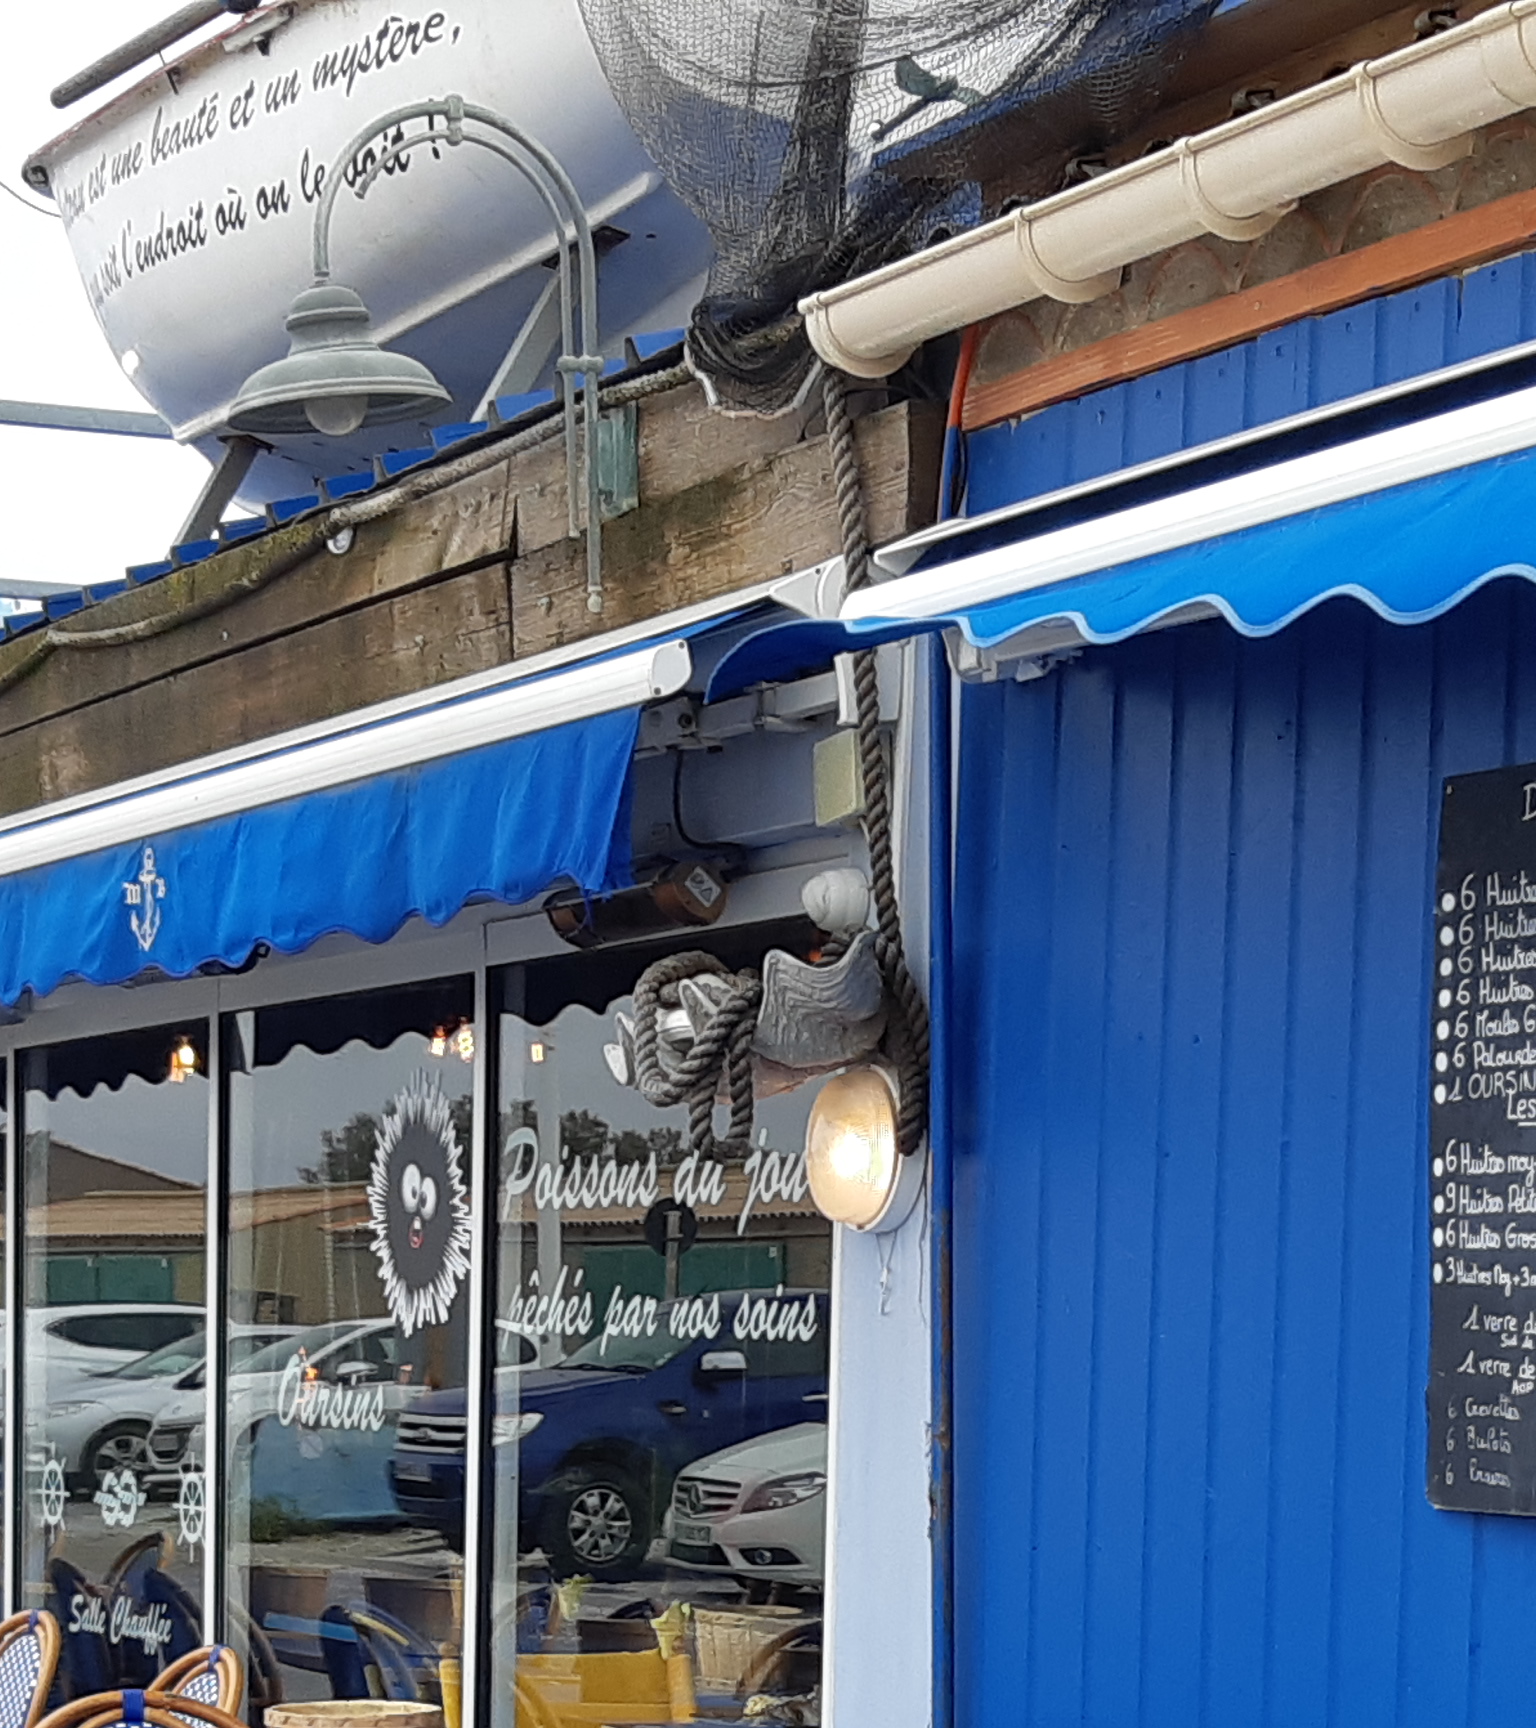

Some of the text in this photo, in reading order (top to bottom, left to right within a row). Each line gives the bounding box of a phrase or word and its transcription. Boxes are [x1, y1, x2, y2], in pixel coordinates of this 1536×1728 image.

[112, 142, 143, 185] une
[151, 92, 219, 165] beauté
[229, 80, 256, 129] et
[264, 69, 302, 113] un
[313, 13, 461, 97] mystère,
[122, 200, 207, 279] l'endroit
[216, 188, 248, 235] où
[256, 180, 291, 218] on
[300, 148, 326, 203] le
[1461, 872, 1476, 911] 6
[1458, 913, 1474, 945] 6
[1457, 946, 1473, 974] 6
[1456, 979, 1471, 1005] 6
[1454, 1010, 1468, 1038] 6
[1453, 1042, 1466, 1068] 6
[1468, 1068, 1536, 1098] OURSIN
[1506, 1088, 1536, 1119] Les
[1445, 1139, 1457, 1172] 6
[502, 1127, 811, 1236] Poissons du jou
[1445, 1182, 1456, 1212] 9
[1446, 1218, 1456, 1248] 6
[1446, 1256, 1456, 1282] 3
[502, 1264, 818, 1356] pêchés par nos soins
[1462, 1304, 1480, 1330] 1
[1483, 1313, 1518, 1333] verre
[1457, 1350, 1476, 1374] 1
[1479, 1359, 1512, 1377] verre
[1518, 1357, 1536, 1380] de
[278, 1354, 385, 1431] Oursins
[68, 1594, 107, 1635] Salle
